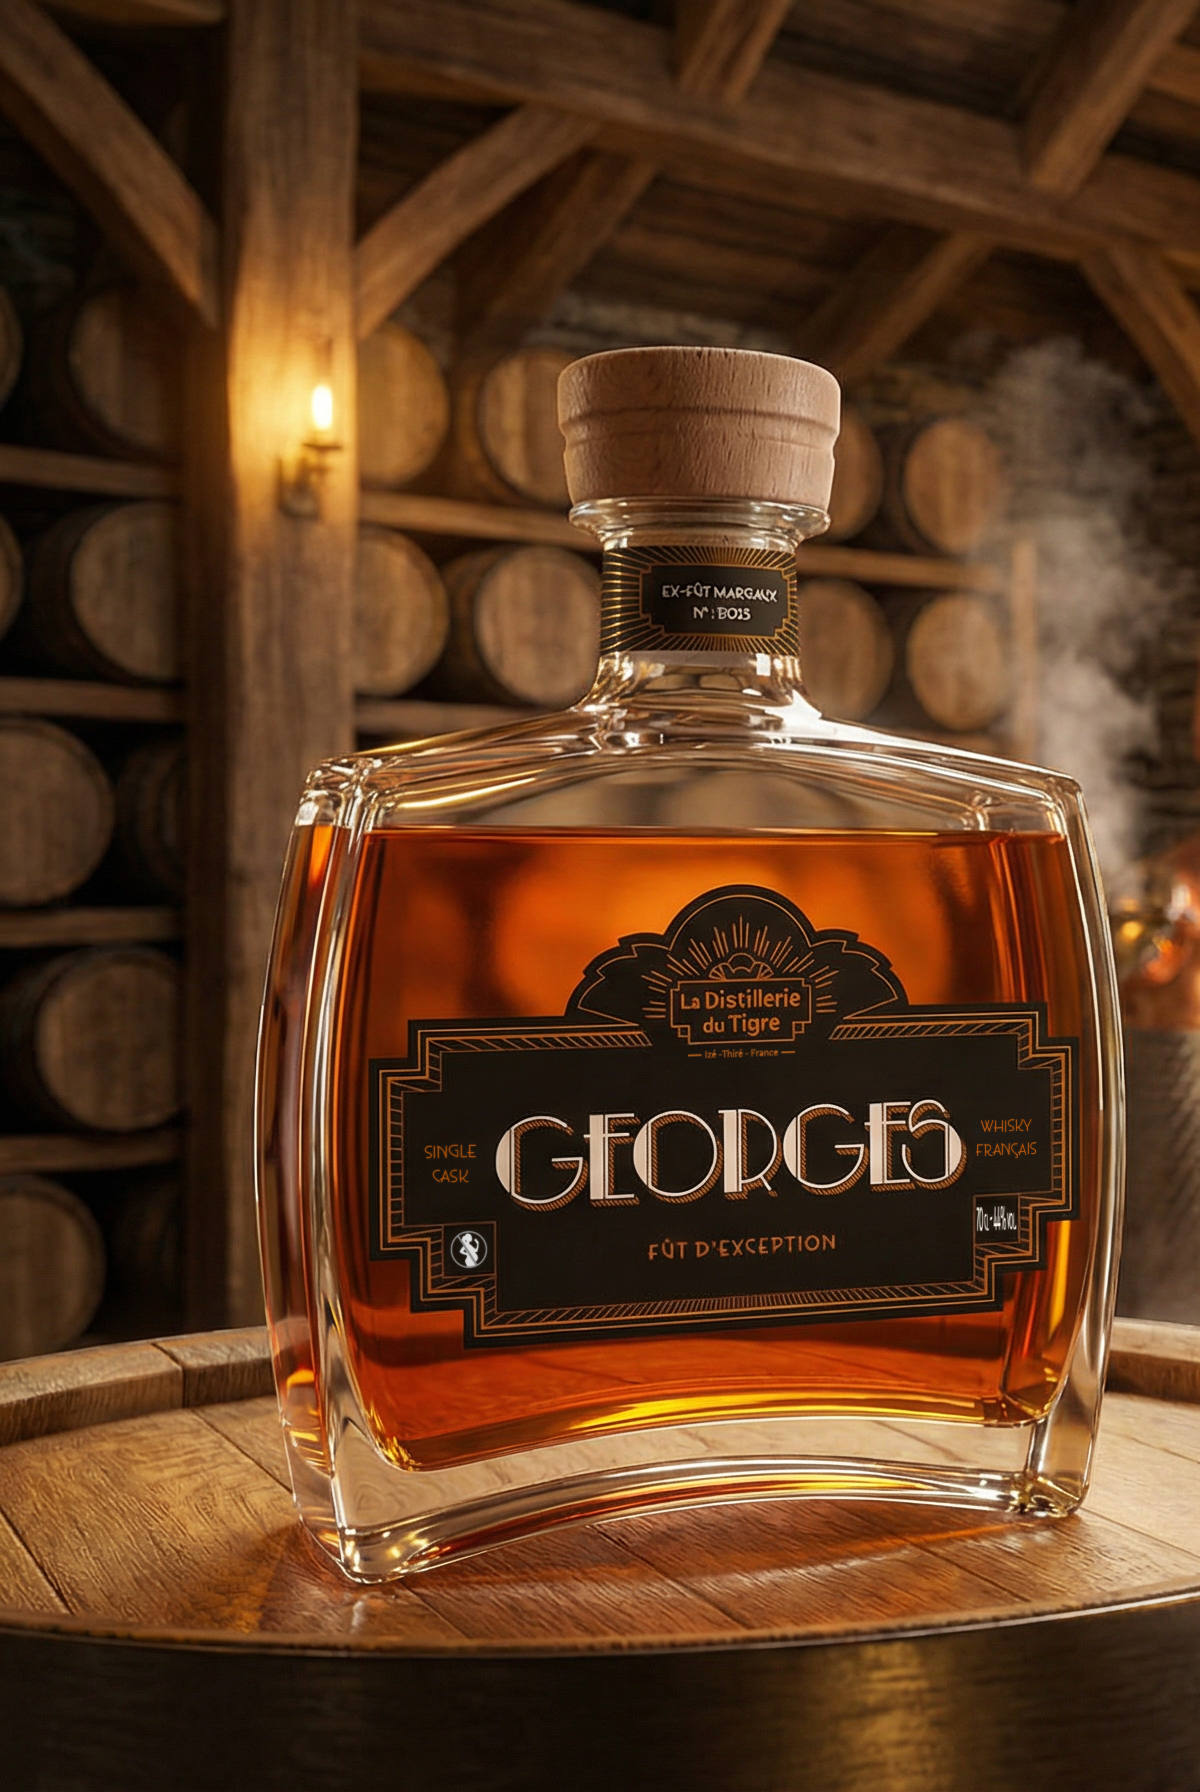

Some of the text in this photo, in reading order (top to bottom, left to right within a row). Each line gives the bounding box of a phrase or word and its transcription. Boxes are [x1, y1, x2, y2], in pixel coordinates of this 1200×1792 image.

[713, 585, 778, 603] MARGAUX
[680, 988, 801, 1010] La Distillerie
[703, 1013, 780, 1037] du Tigre
[750, 1048, 779, 1057] France
[980, 1118, 1033, 1133] WHISKY
[424, 1144, 477, 1159] SINGLE
[495, 1099, 967, 1213] GEORGES
[976, 1141, 1037, 1159] FRANÇAIS
[432, 1169, 469, 1183] CASK
[648, 1234, 837, 1261] FÛT D'EXCEPTION
